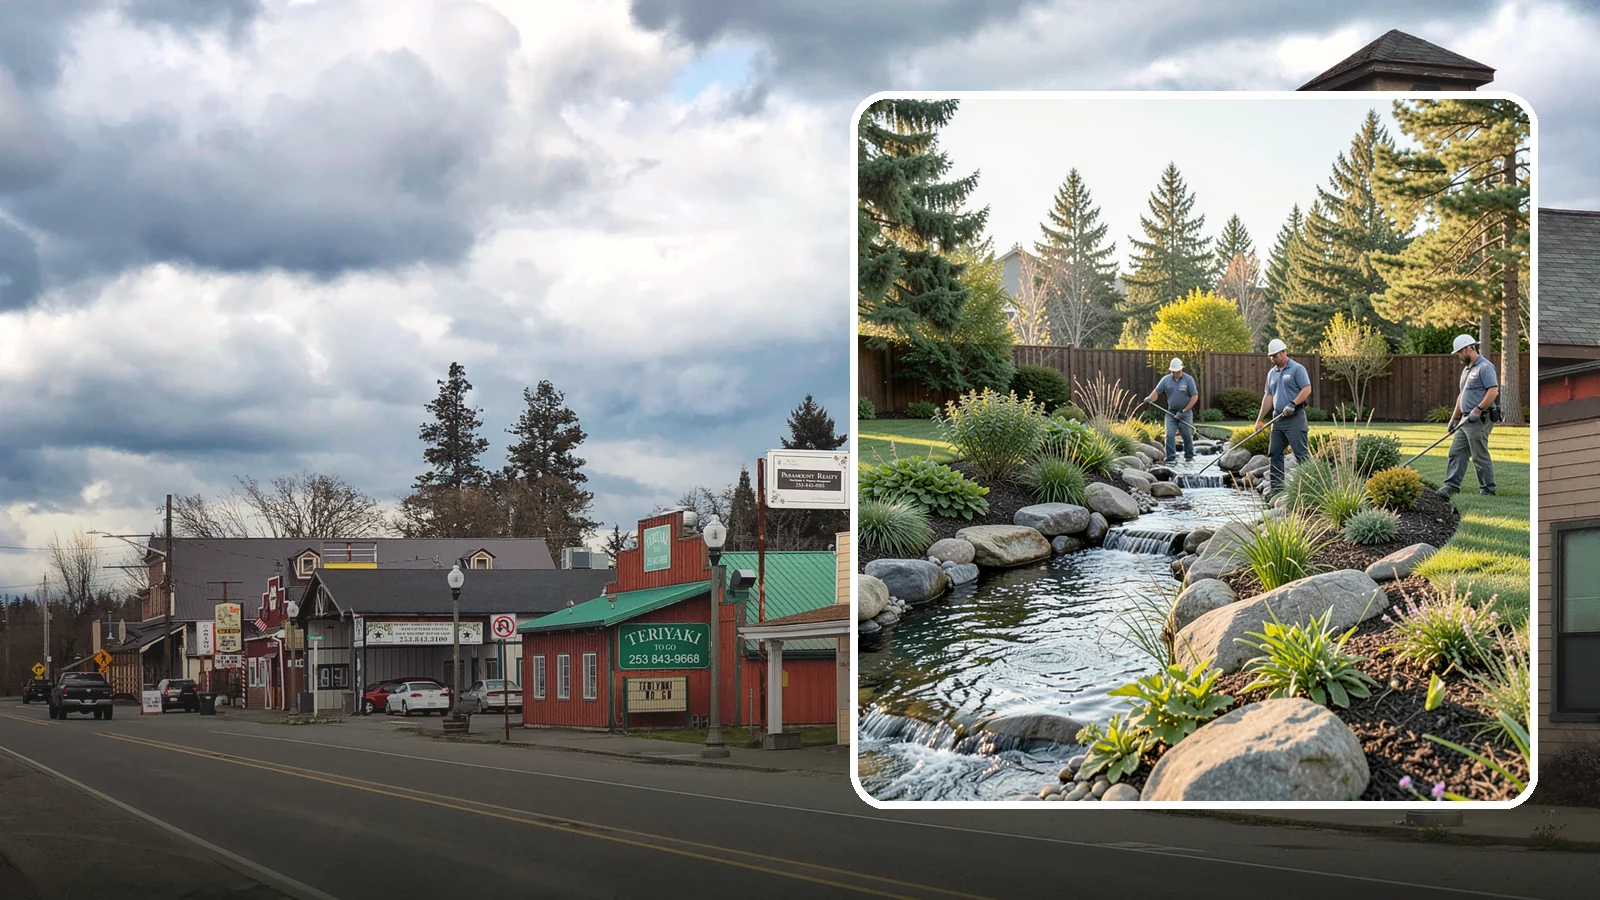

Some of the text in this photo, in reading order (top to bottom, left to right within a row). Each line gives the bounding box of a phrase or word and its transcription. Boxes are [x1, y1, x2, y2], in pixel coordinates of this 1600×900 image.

[624, 627, 702, 646] TERIYAKI
[629, 653, 700, 665] 253 843-9668
